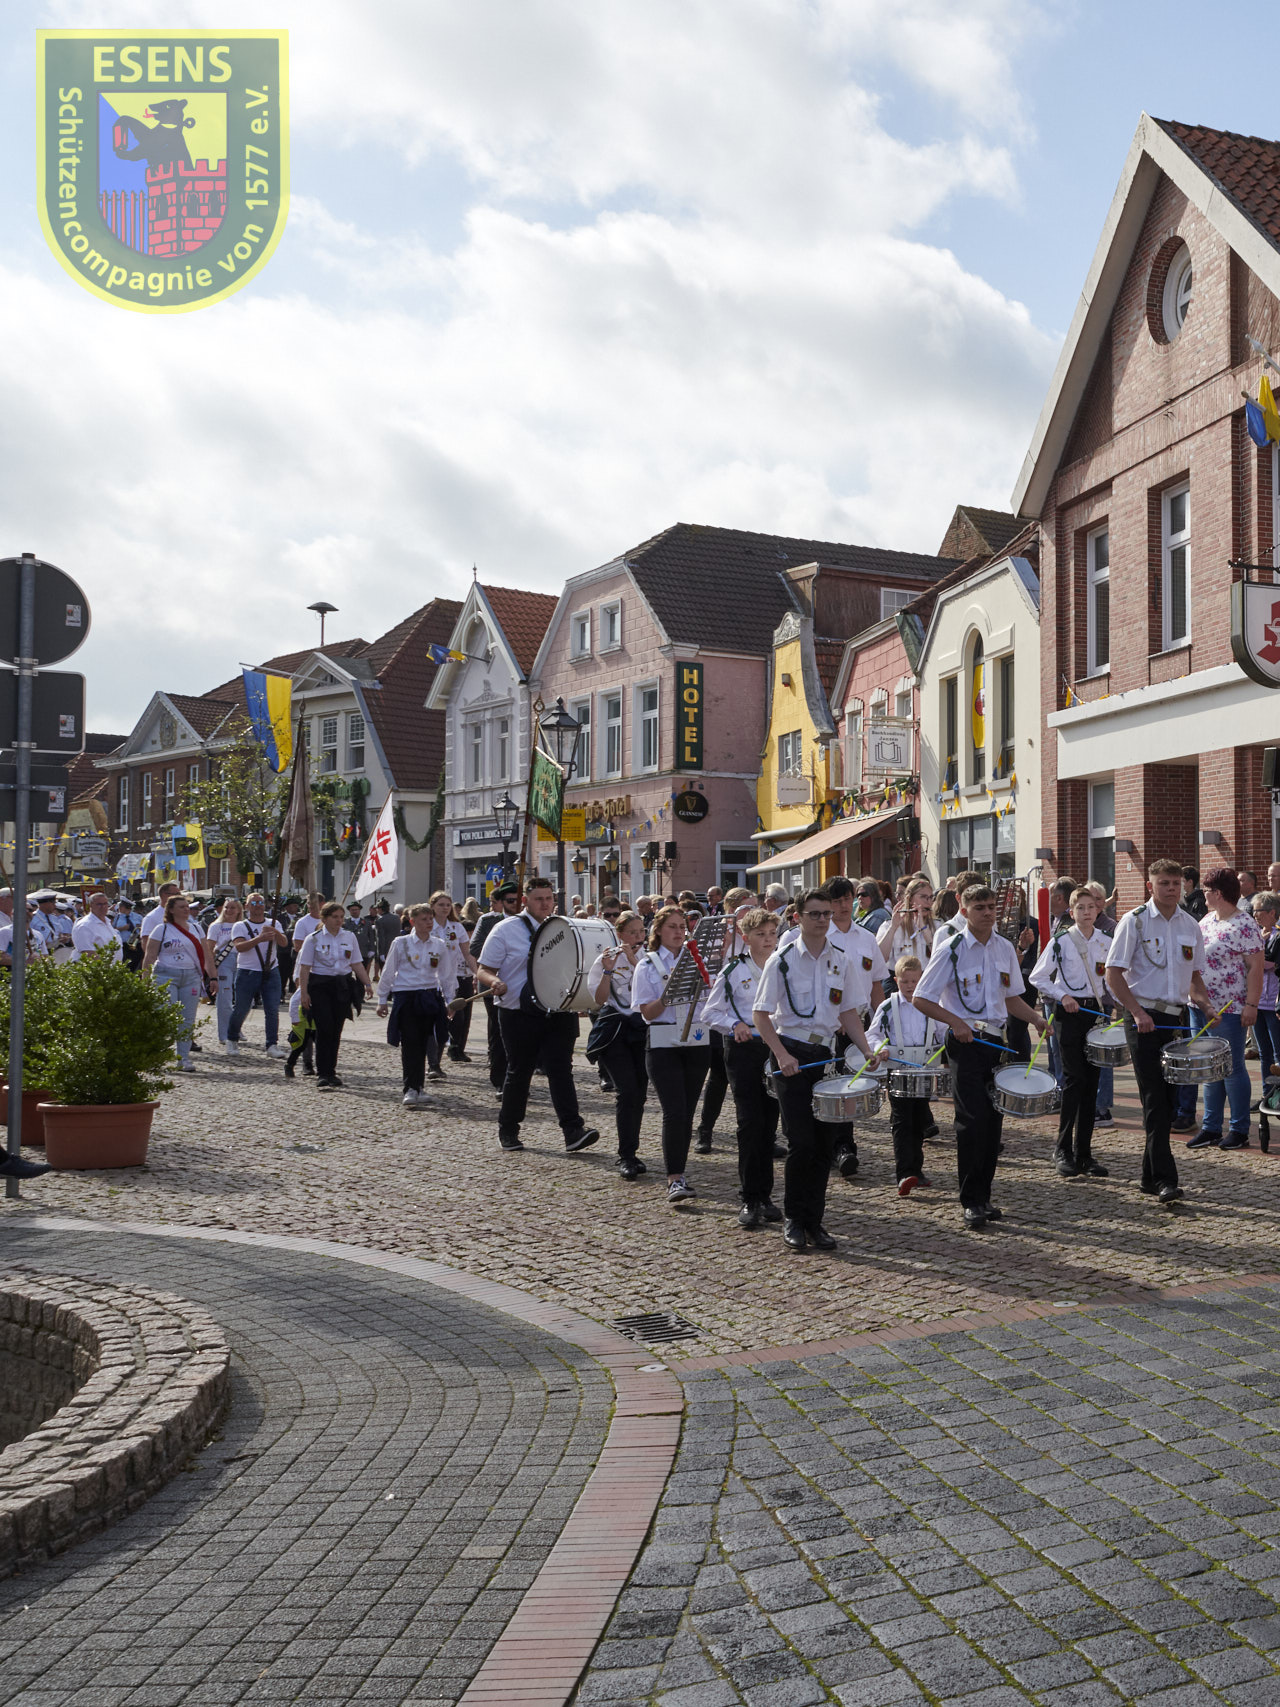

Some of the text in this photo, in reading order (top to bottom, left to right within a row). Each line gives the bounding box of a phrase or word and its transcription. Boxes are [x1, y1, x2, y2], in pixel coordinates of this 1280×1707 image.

[683, 668, 699, 762] HOTEL
[678, 810, 703, 818] GUINNESS
[545, 930, 565, 954] SONOR
